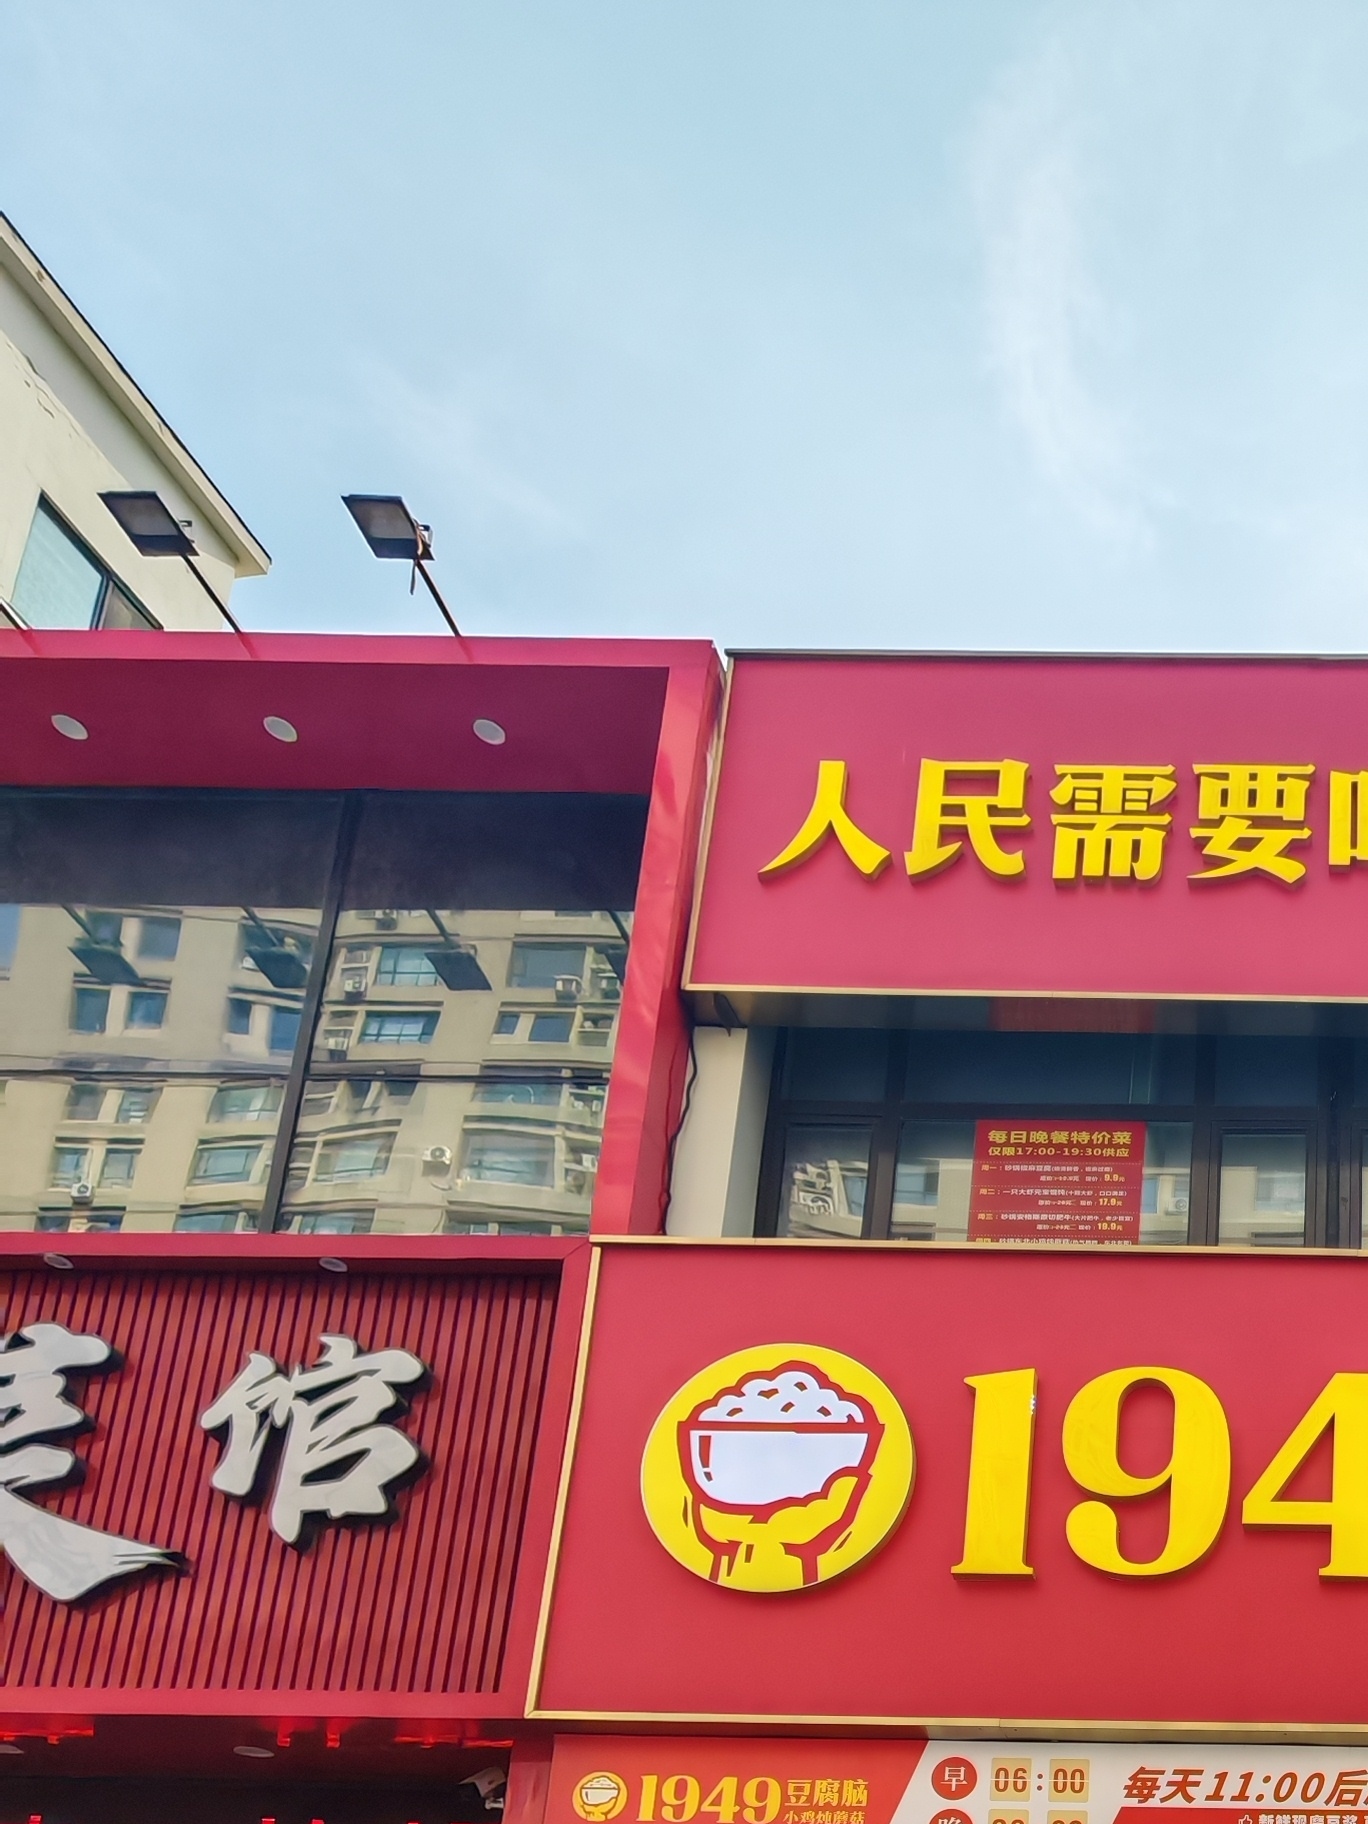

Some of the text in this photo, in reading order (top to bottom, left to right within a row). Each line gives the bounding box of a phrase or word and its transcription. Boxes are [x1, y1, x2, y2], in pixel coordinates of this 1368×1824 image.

[988, 1130, 1133, 1145] 每日晚餐特价菜
[988, 1147, 1130, 1157] 仅限17:00-19:30供应
[940, 1765, 1087, 1794] 早 06:00
[635, 1774, 869, 1824] 1949 豆腐脑
